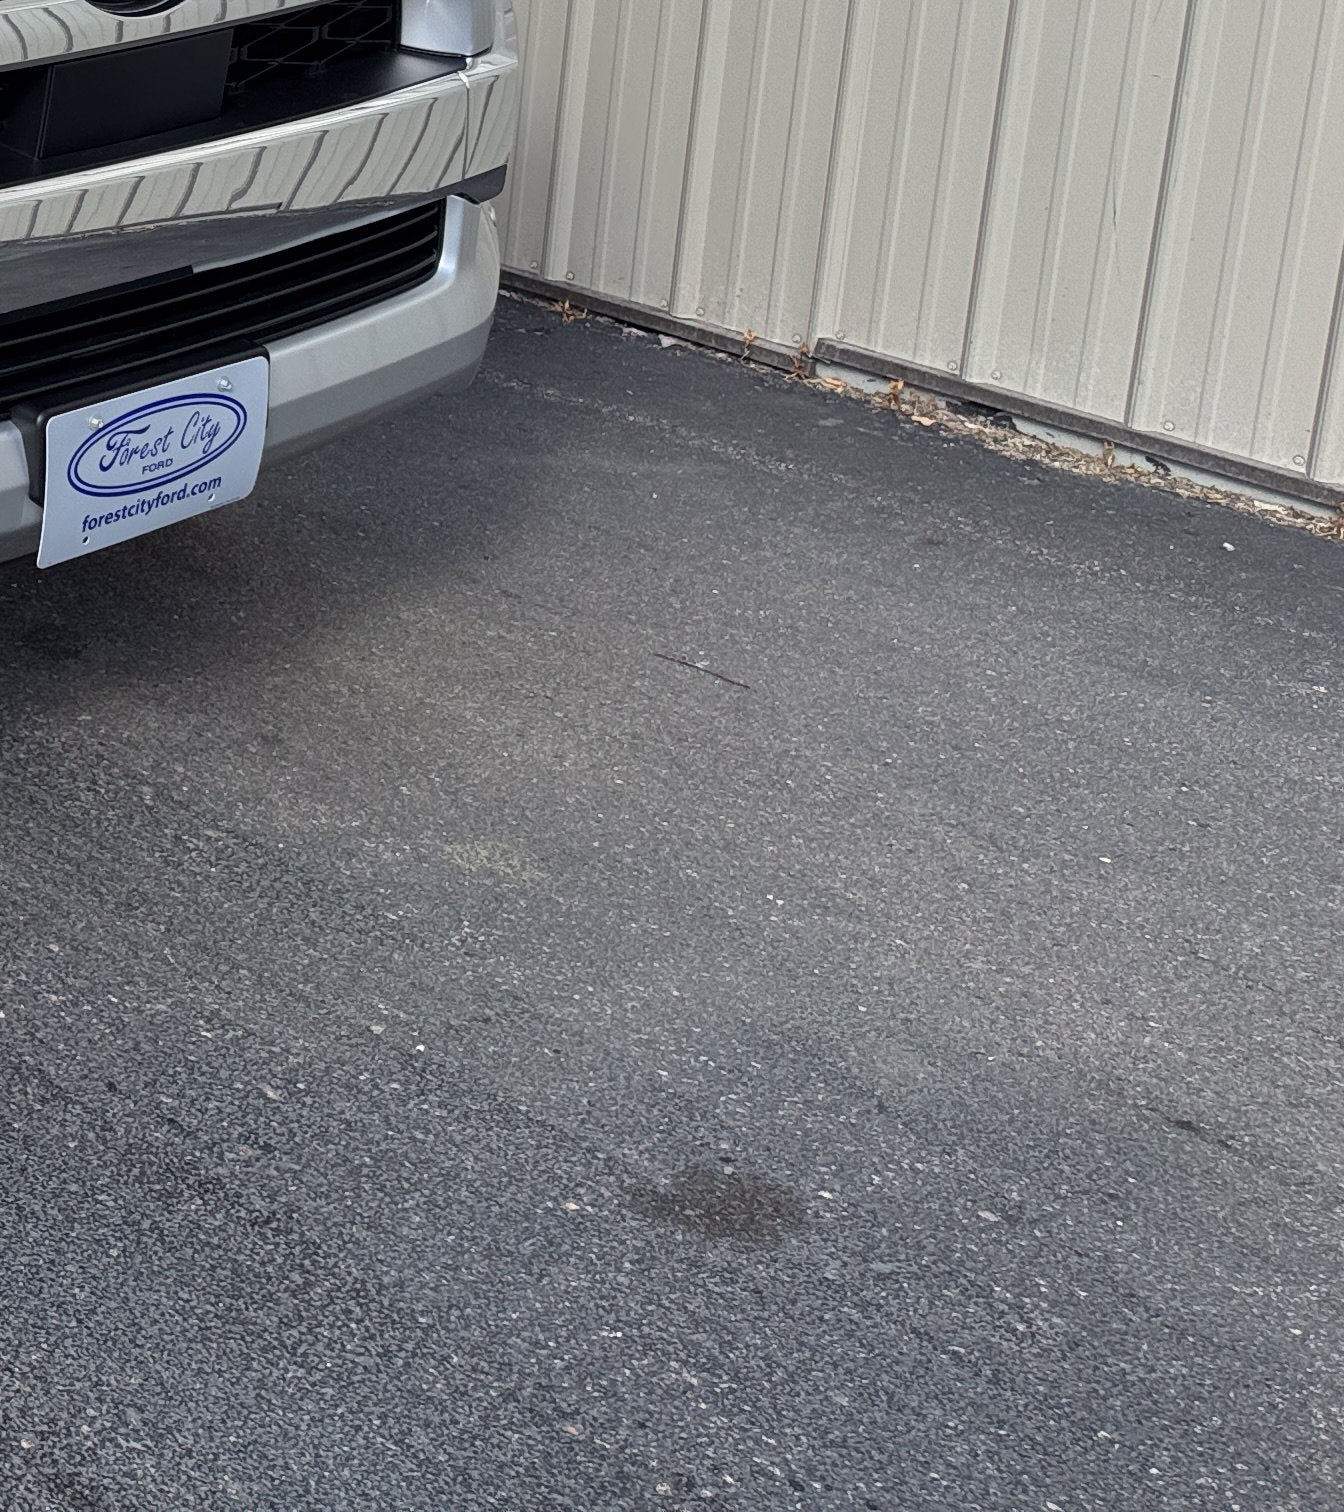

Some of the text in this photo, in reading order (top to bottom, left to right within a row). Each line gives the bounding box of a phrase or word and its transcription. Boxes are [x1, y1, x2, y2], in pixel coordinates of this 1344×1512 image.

[99, 410, 222, 473] Forest City
[142, 458, 173, 475] FORD
[81, 475, 222, 533] forestcityford.com
